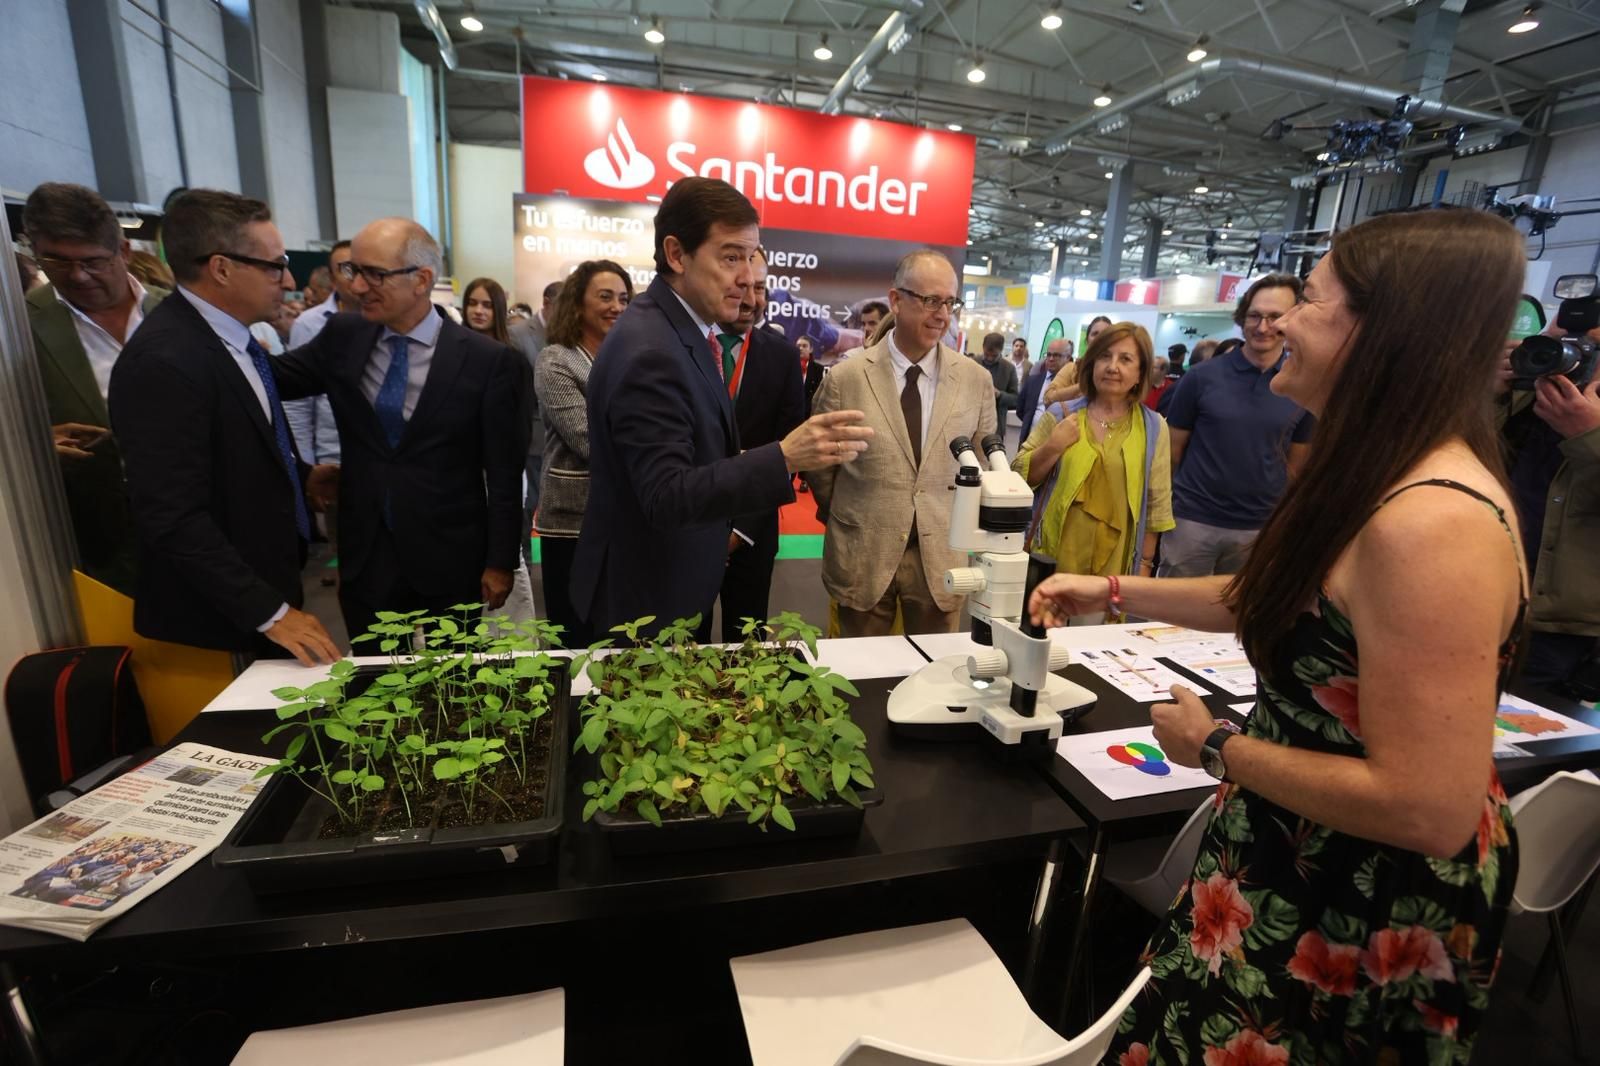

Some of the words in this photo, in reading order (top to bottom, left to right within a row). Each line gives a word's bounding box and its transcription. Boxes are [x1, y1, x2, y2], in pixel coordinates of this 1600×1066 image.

[666, 141, 928, 217] Santander
[521, 205, 548, 227] Tu
[553, 208, 645, 234] esfuerzo
[523, 234, 550, 252] en
[557, 237, 628, 257] manos
[763, 246, 818, 269] uerzo
[766, 274, 801, 291] nos
[765, 301, 831, 321] pertas
[189, 751, 215, 763] LA
[216, 757, 270, 771] GACE
